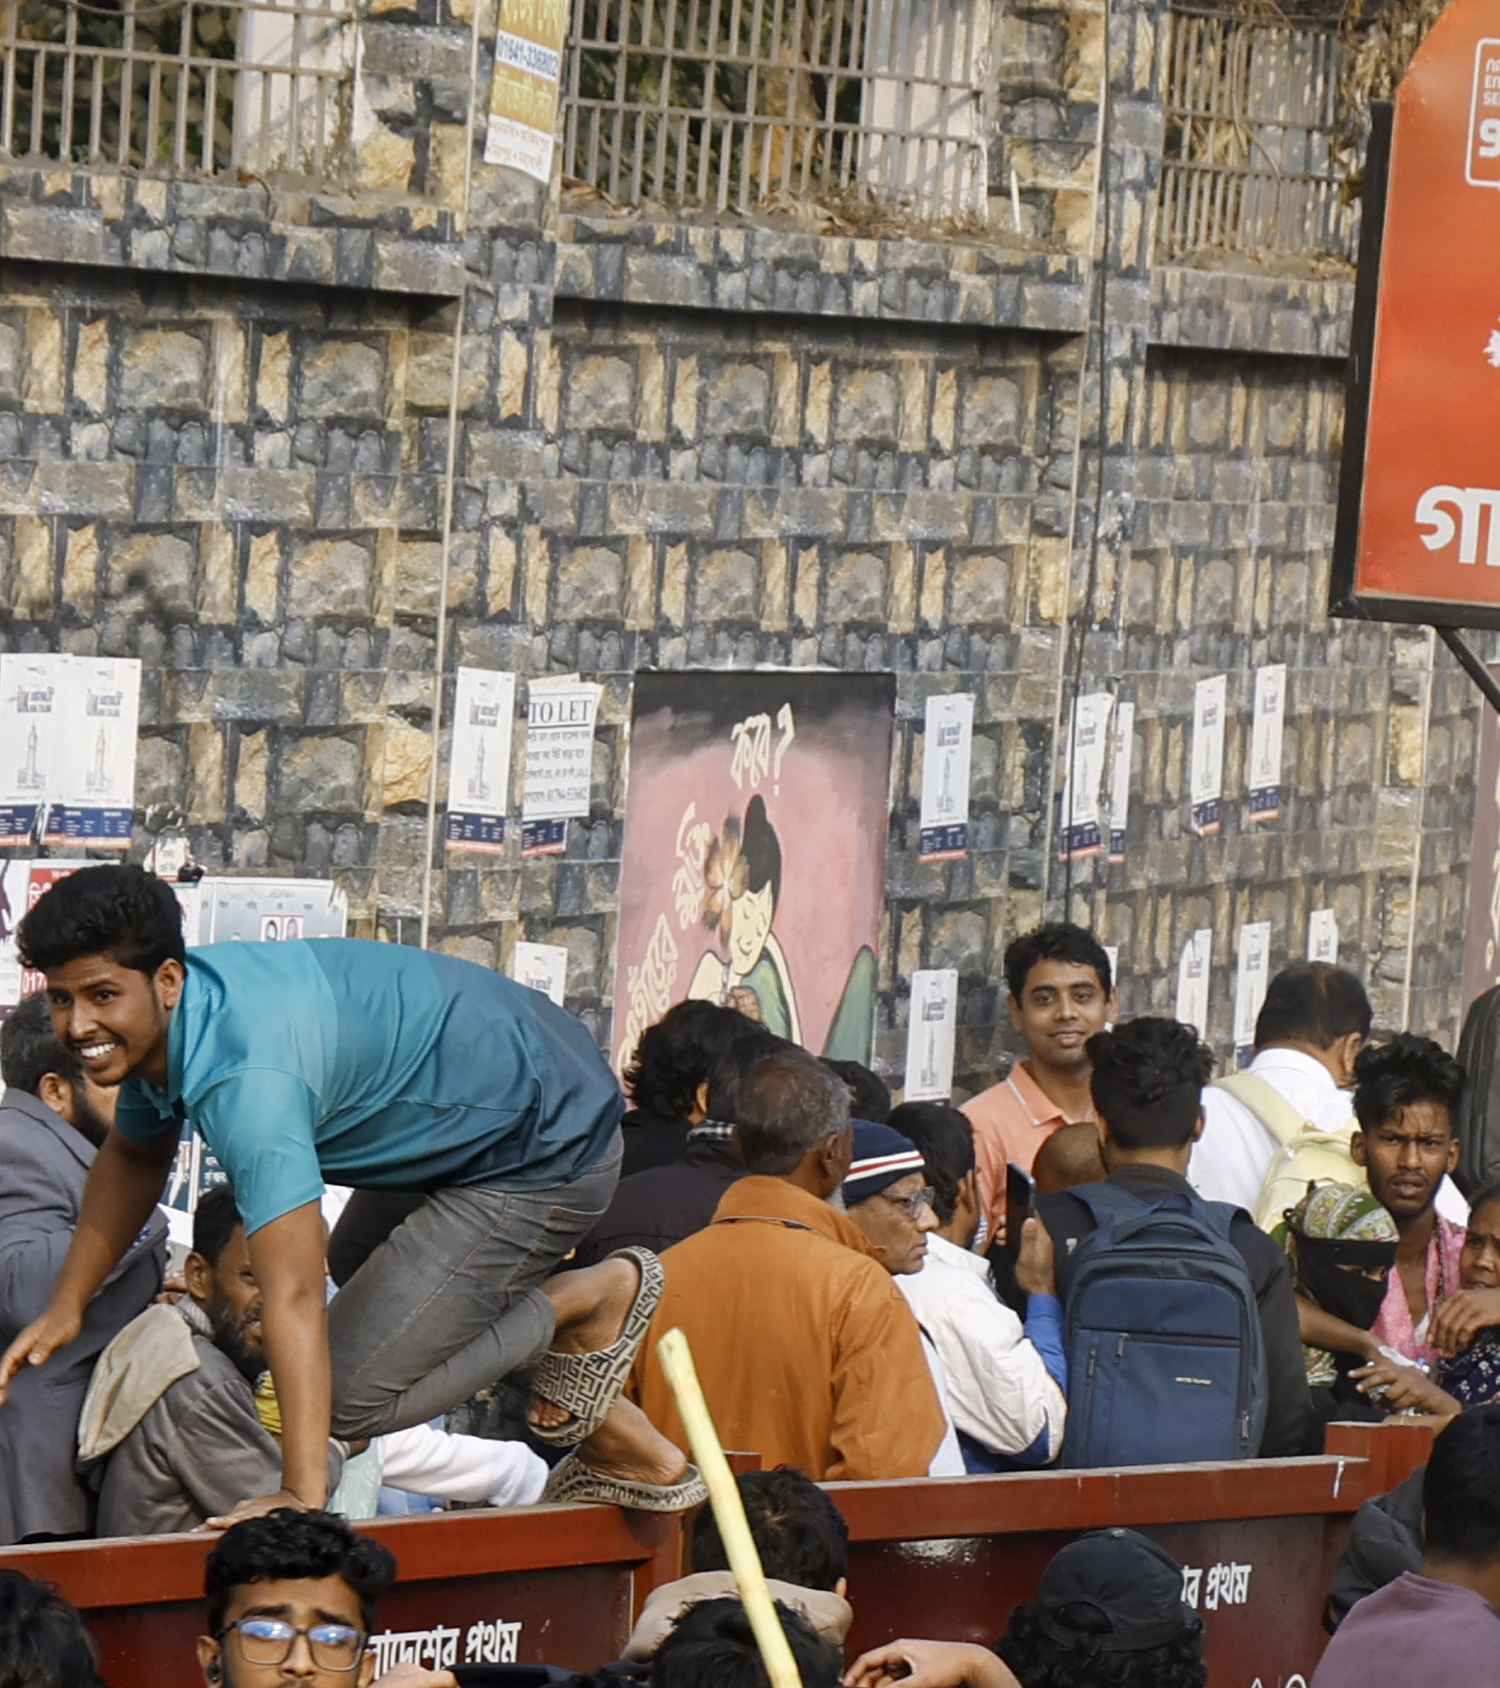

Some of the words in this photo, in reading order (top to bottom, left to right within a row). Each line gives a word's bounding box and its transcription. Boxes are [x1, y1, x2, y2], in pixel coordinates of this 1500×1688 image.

[529, 701, 553, 724] TO
[558, 699, 592, 722] LET
[1205, 1561, 1252, 1611] প্রথম
